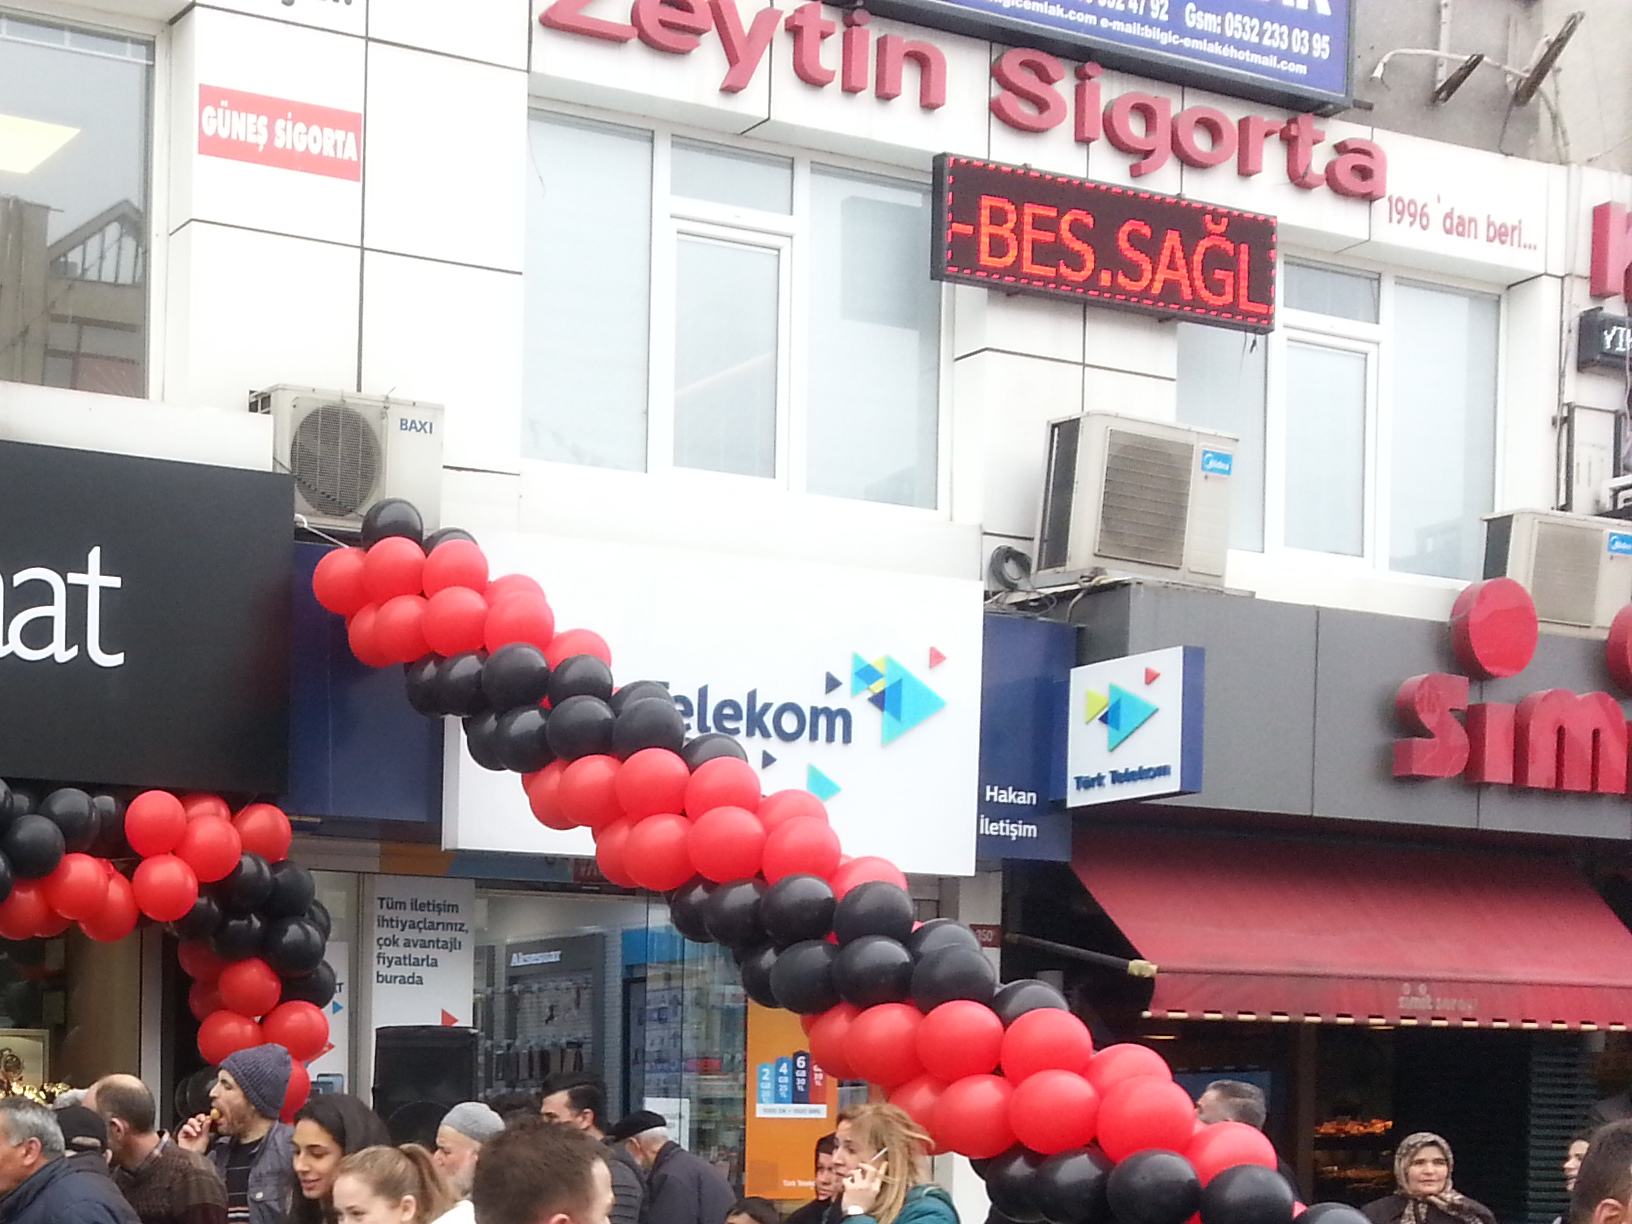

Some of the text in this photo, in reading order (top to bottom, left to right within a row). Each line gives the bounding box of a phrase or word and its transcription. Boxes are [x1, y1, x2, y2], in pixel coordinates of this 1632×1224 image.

[1150, 0, 1169, 21] 92
[1185, 2, 1222, 34] Gsm:
[1225, 12, 1259, 43] 0532
[1263, 21, 1288, 50] 233
[1292, 28, 1309, 55] 03
[1312, 33, 1330, 60] 95
[201, 101, 358, 162] GÜNEŞ SİGORTA
[989, 47, 1388, 201] Sigorta
[1387, 195, 1430, 231] 1996
[1486, 214, 1537, 251] beri...
[399, 418, 433, 434] BAXI
[655, 681, 853, 745] elekom
[1074, 764, 1172, 792] Türk Telekom
[986, 785, 1037, 806] Hakan
[979, 815, 1038, 841] İletişim
[377, 897, 459, 916] Tüm iletişim
[377, 916, 469, 934] ihtiyaçlarınız,
[376, 935, 462, 953] çok avantajlı
[376, 953, 438, 968] fiyatlarla
[376, 971, 424, 985] burada
[779, 1063, 788, 1075] 4
[796, 1056, 806, 1069] 6
[762, 1068, 770, 1080] 2
